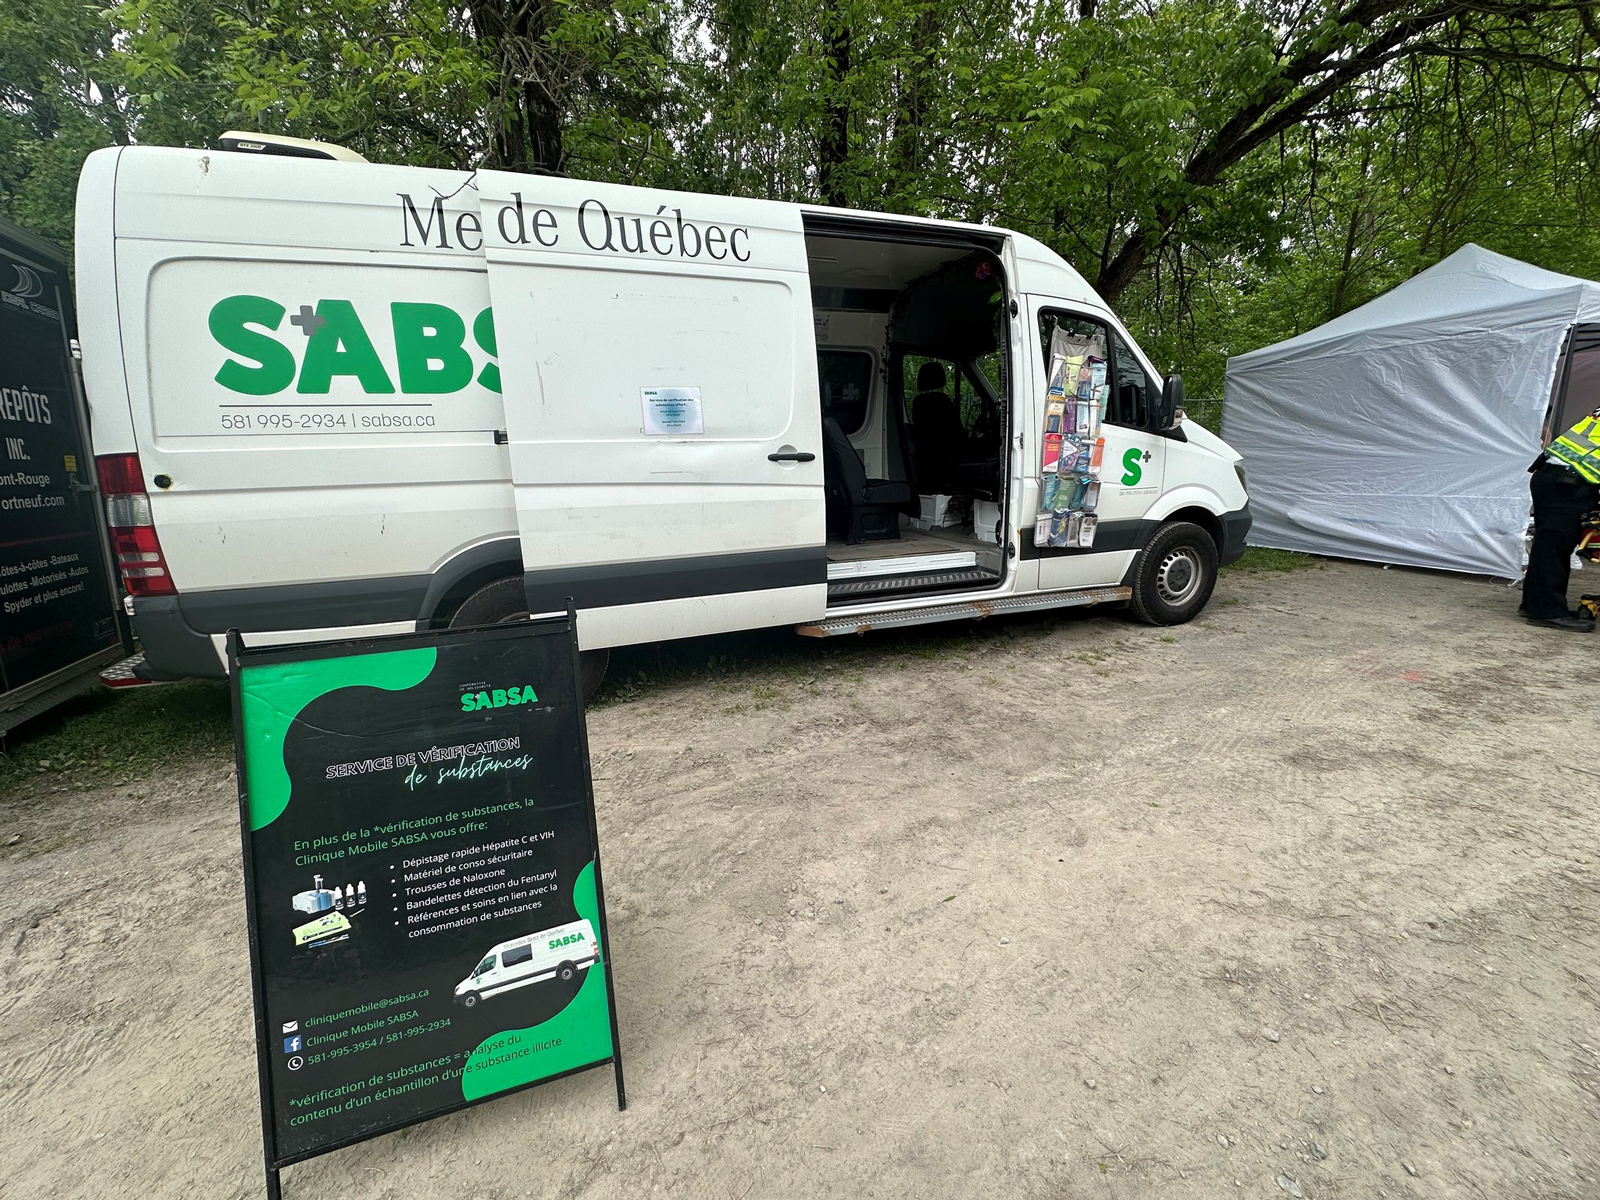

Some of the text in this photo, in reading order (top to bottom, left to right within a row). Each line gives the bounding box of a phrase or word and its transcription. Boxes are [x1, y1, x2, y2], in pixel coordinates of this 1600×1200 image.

[396, 192, 752, 262] Me de Québec
[221, 414, 252, 429] 581
[257, 413, 347, 428] 995-2934
[361, 413, 436, 427] sabsa.ca
[5, 437, 31, 460] INC.
[1, 494, 66, 510] ortneuf.com
[0, 558, 49, 577] ôtes-à-côtes
[3, 581, 85, 614] Spyder et plus encore!
[461, 685, 539, 712] SABSA
[325, 736, 521, 779] SERVICE DE VÉRIFICATION
[404, 752, 534, 791] de substances
[294, 840, 310, 851] En
[313, 835, 339, 850] plus
[342, 831, 357, 842] de
[360, 828, 371, 838] la
[445, 812, 459, 822] de
[461, 800, 523, 819] substances,
[525, 797, 535, 807] la
[295, 821, 488, 866] Clinique Mobile SABSA vous offre:
[403, 830, 555, 869] Dépistage rapide Hépatite C et VIH
[404, 848, 533, 883] Matériel de conso sécuritaire
[405, 867, 506, 896] Trousses de Naloxone
[406, 869, 558, 911] Bandelettes détection du Fentanyl
[407, 883, 558, 925] Références et soins en lien avec la
[408, 900, 543, 938] consommation de substances
[548, 932, 585, 950] SABSA
[305, 989, 430, 1028] cliniquemobile@sabsa.ca
[306, 1009, 419, 1047] Clinique Mobile SABSA
[308, 1018, 452, 1065] 581-995-3954 / 581-995-2934
[368, 1075, 384, 1087] de
[387, 1055, 451, 1081] substances
[507, 1035, 522, 1046] du
[290, 1104, 342, 1127] contenu
[345, 1094, 372, 1110] d'un
[375, 1074, 439, 1101] échantillon
[475, 1047, 530, 1071] substance
[532, 1037, 563, 1054] illicite
